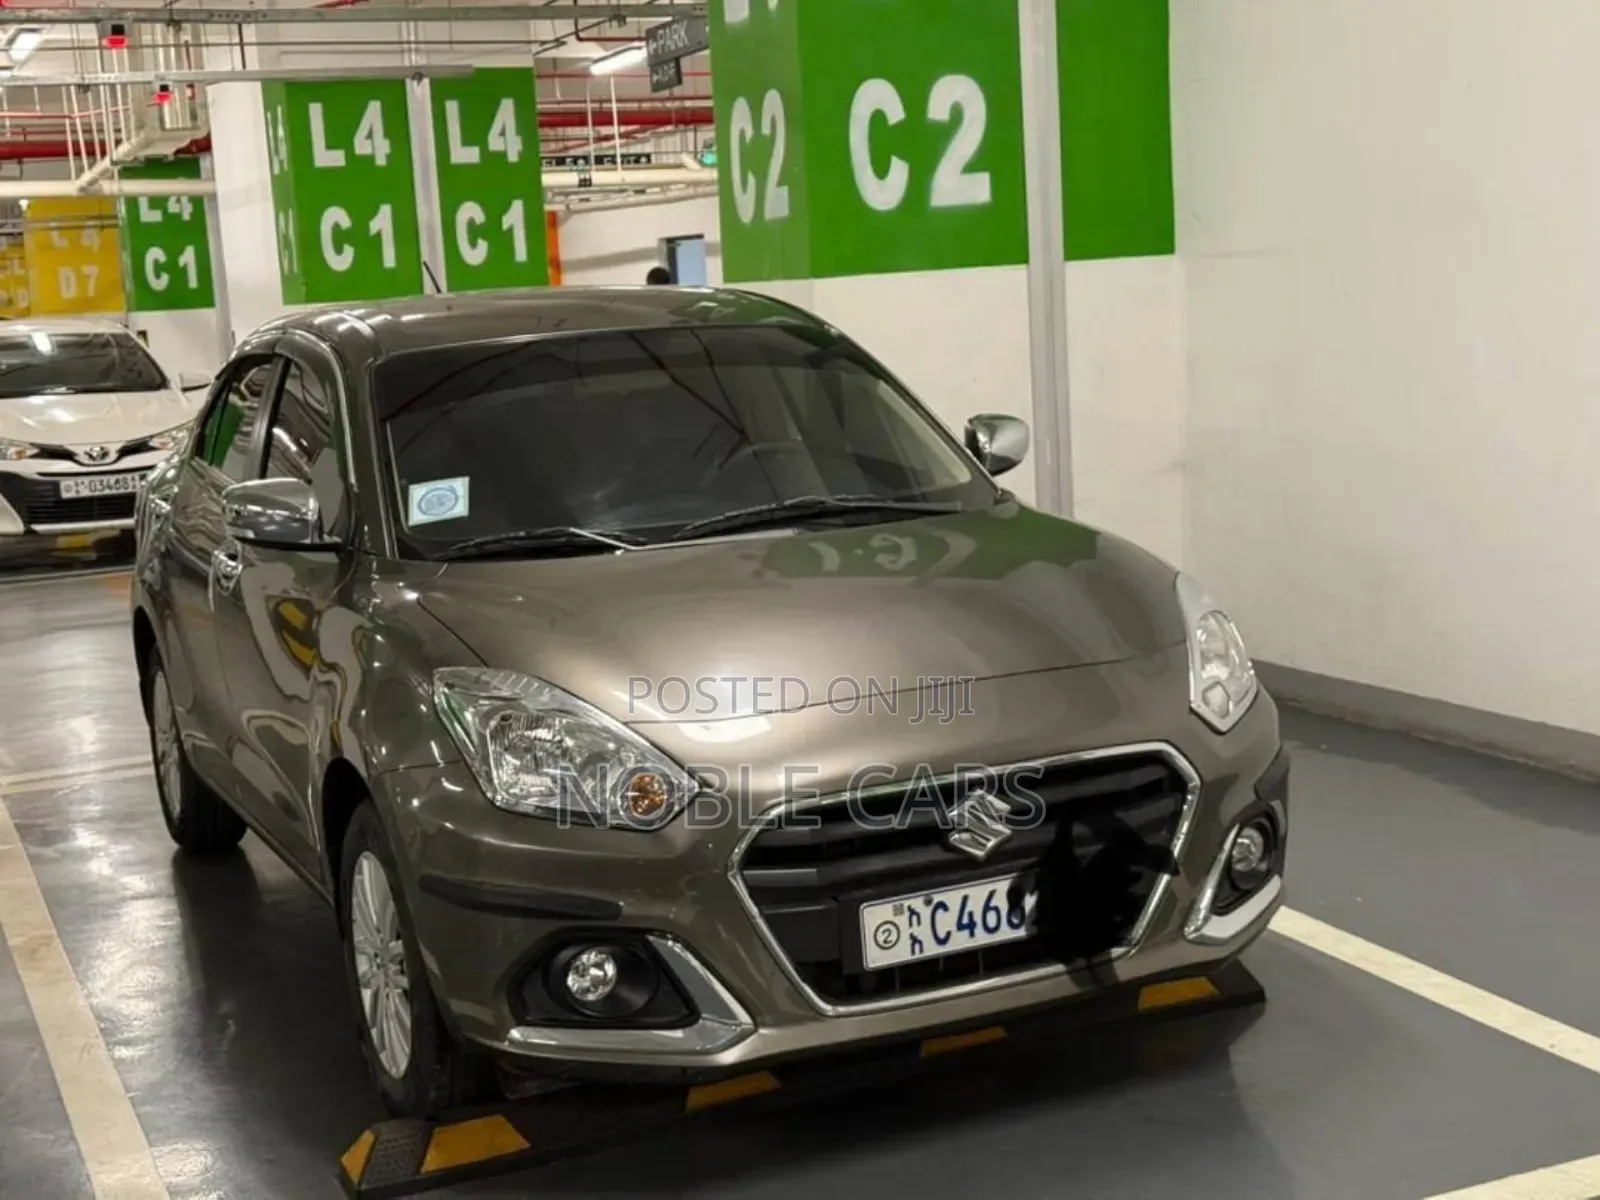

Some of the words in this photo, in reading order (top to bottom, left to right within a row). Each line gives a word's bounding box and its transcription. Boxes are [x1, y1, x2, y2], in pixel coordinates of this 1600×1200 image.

[308, 100, 391, 168] L4
[445, 98, 523, 164] L4
[730, 88, 790, 223] C2
[849, 74, 992, 211] C2
[319, 204, 396, 272] C1
[455, 200, 527, 266] C1
[144, 245, 199, 292] C1
